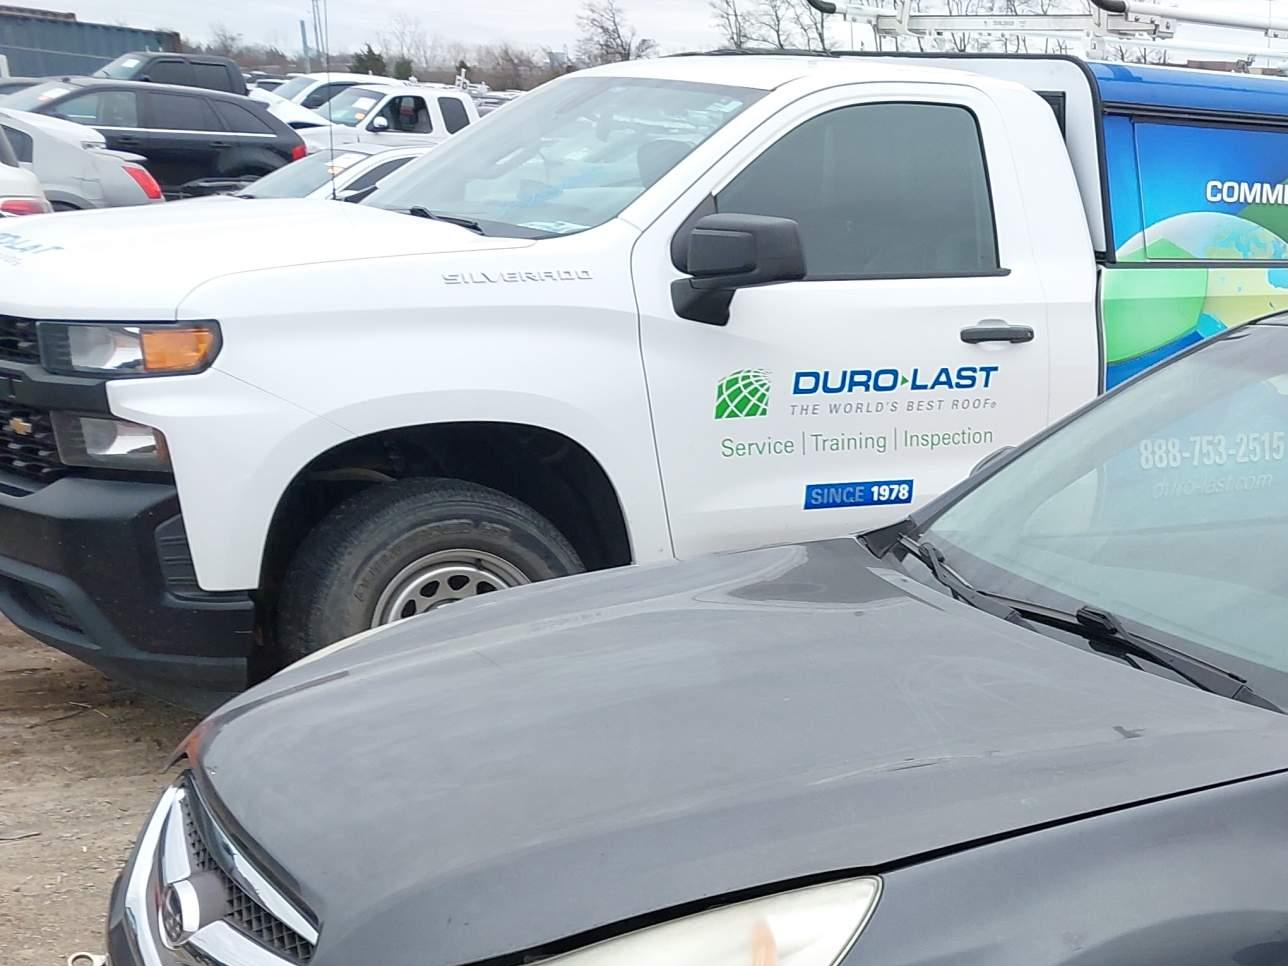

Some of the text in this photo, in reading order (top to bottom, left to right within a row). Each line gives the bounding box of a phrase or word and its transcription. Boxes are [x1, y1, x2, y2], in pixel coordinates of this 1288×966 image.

[441, 270, 593, 285] SILVERADO
[789, 404, 821, 416] THE
[828, 401, 899, 415] WORLD'S
[905, 399, 945, 412] BEST
[721, 427, 994, 458] Service Training Inspection
[1139, 431, 1286, 469] 888-753-2515
[810, 484, 910, 506] SINCE 1978
